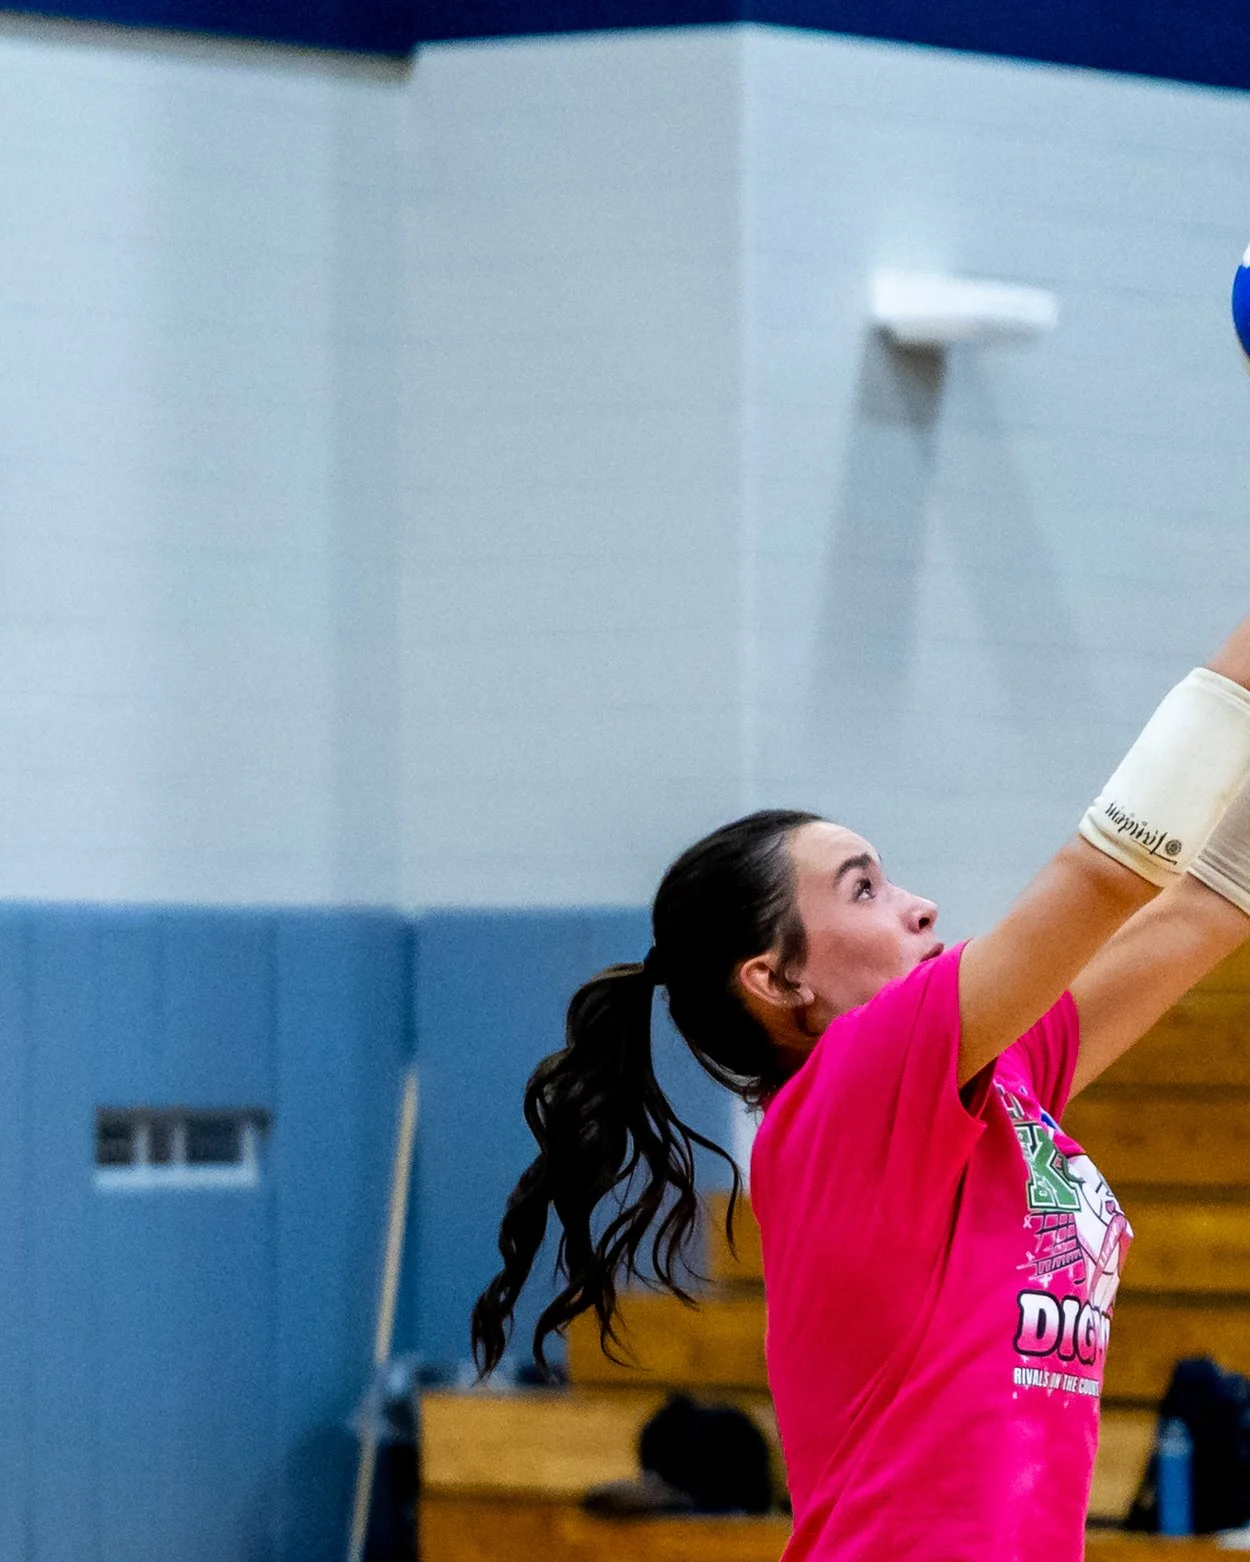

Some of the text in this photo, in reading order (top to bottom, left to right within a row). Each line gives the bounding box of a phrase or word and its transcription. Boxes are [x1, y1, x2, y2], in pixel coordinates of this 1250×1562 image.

[1105, 802, 1177, 865] Tandem
[1013, 1289, 1097, 1365] DIG
[1014, 1367, 1049, 1388] RIVALS
[1062, 1374, 1078, 1392] THE
